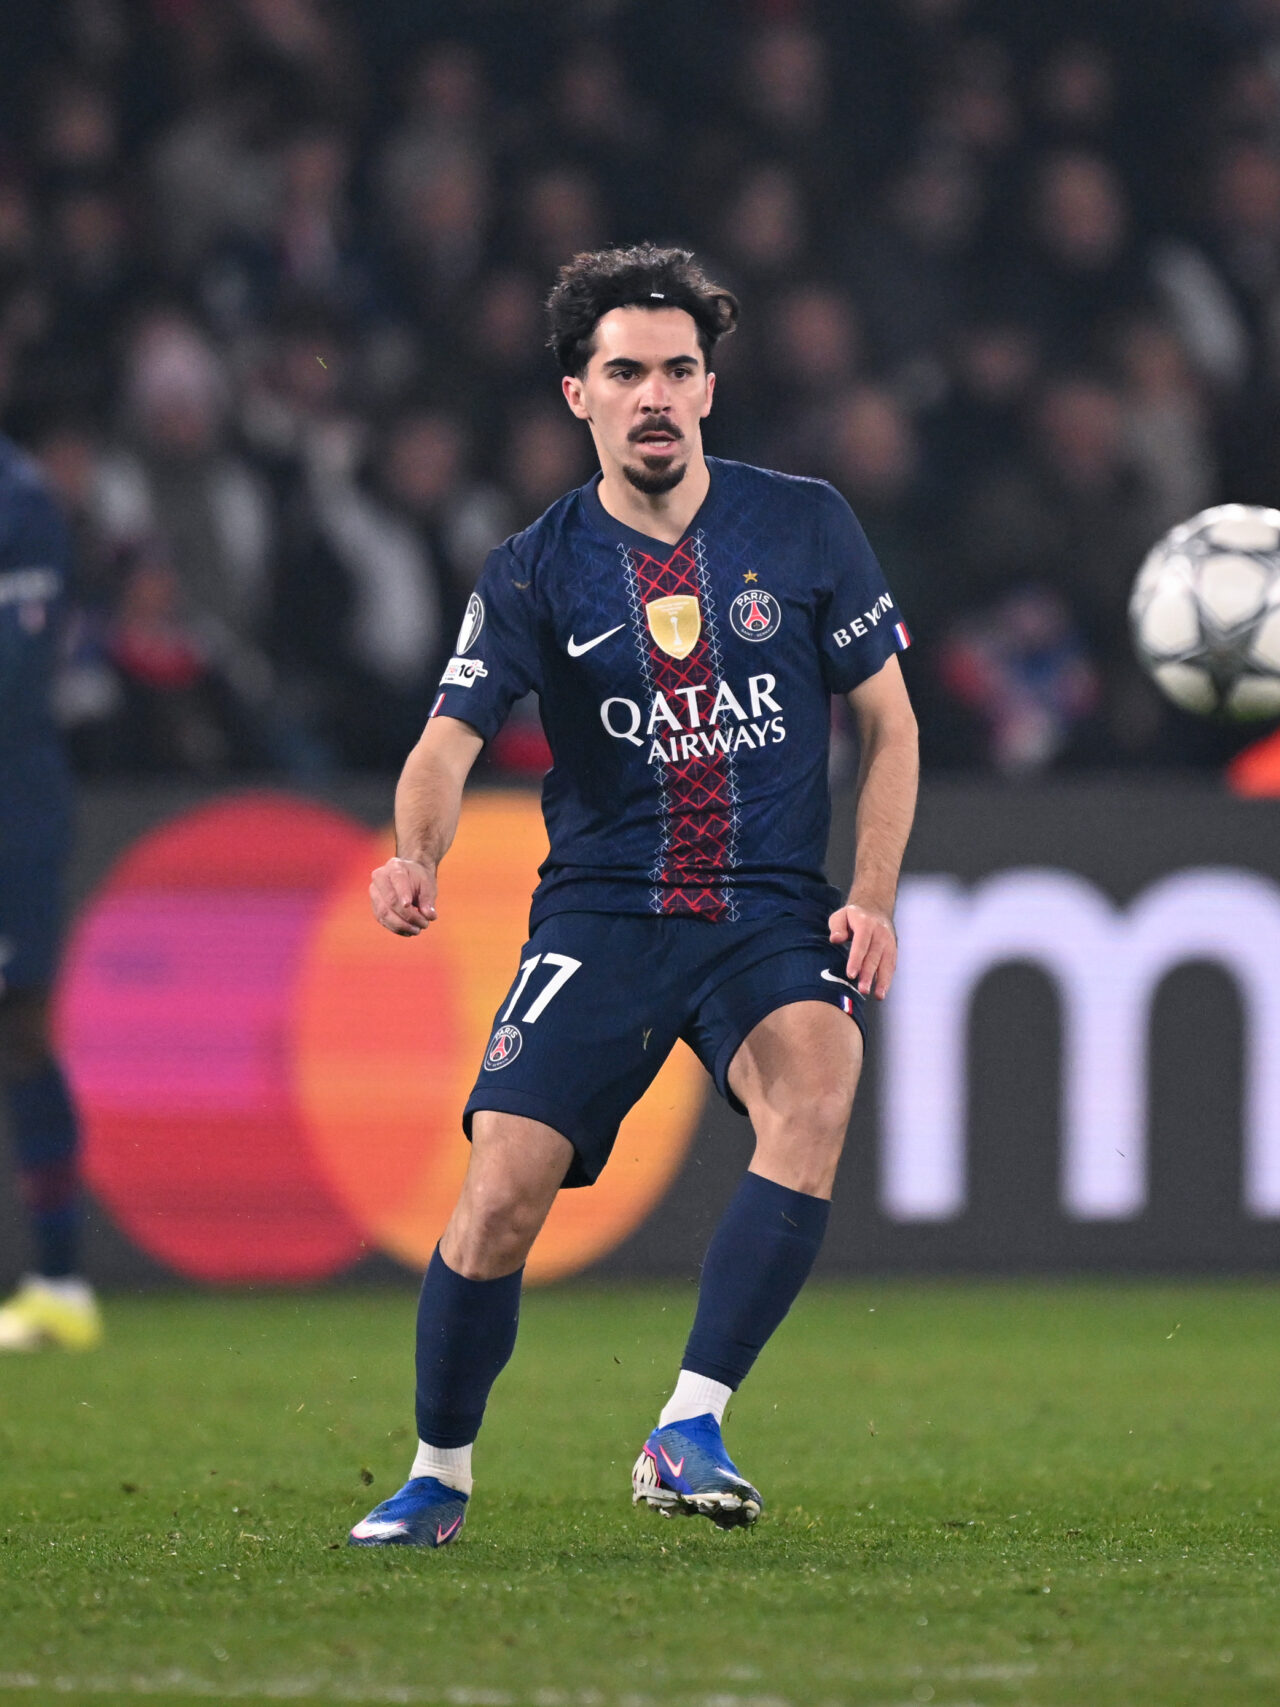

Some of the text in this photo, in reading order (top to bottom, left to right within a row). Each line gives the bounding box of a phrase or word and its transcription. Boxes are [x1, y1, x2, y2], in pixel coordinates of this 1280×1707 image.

[736, 592, 770, 607] PARIS
[600, 673, 783, 747] QATAR
[647, 716, 786, 765] AIRWAYS
[501, 952, 583, 1024] 17
